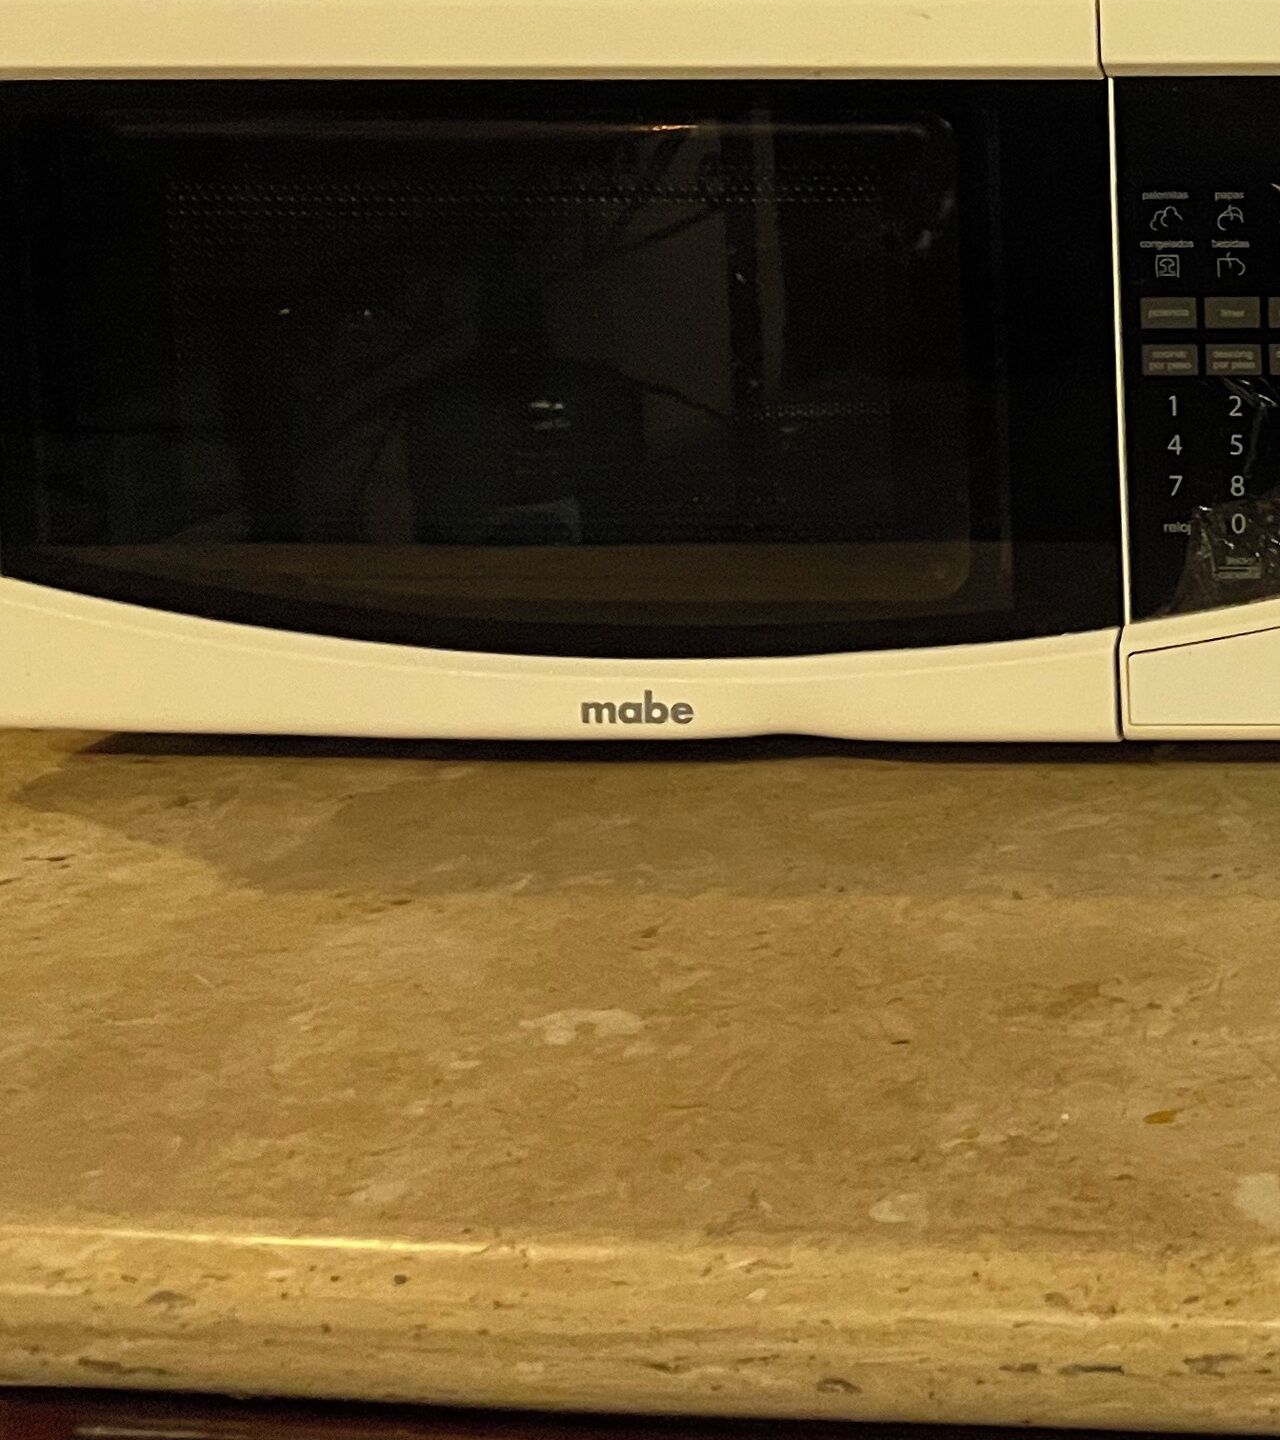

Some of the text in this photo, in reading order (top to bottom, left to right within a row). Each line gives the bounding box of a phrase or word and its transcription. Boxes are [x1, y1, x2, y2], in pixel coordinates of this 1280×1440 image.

[1169, 395, 1177, 416] 1
[1228, 395, 1243, 416] 2
[1167, 434, 1183, 455] 4
[1230, 434, 1243, 455] 5
[1168, 475, 1183, 496] 7
[1230, 475, 1245, 496] 8
[1231, 513, 1246, 534] 0
[581, 689, 695, 724] mabe
